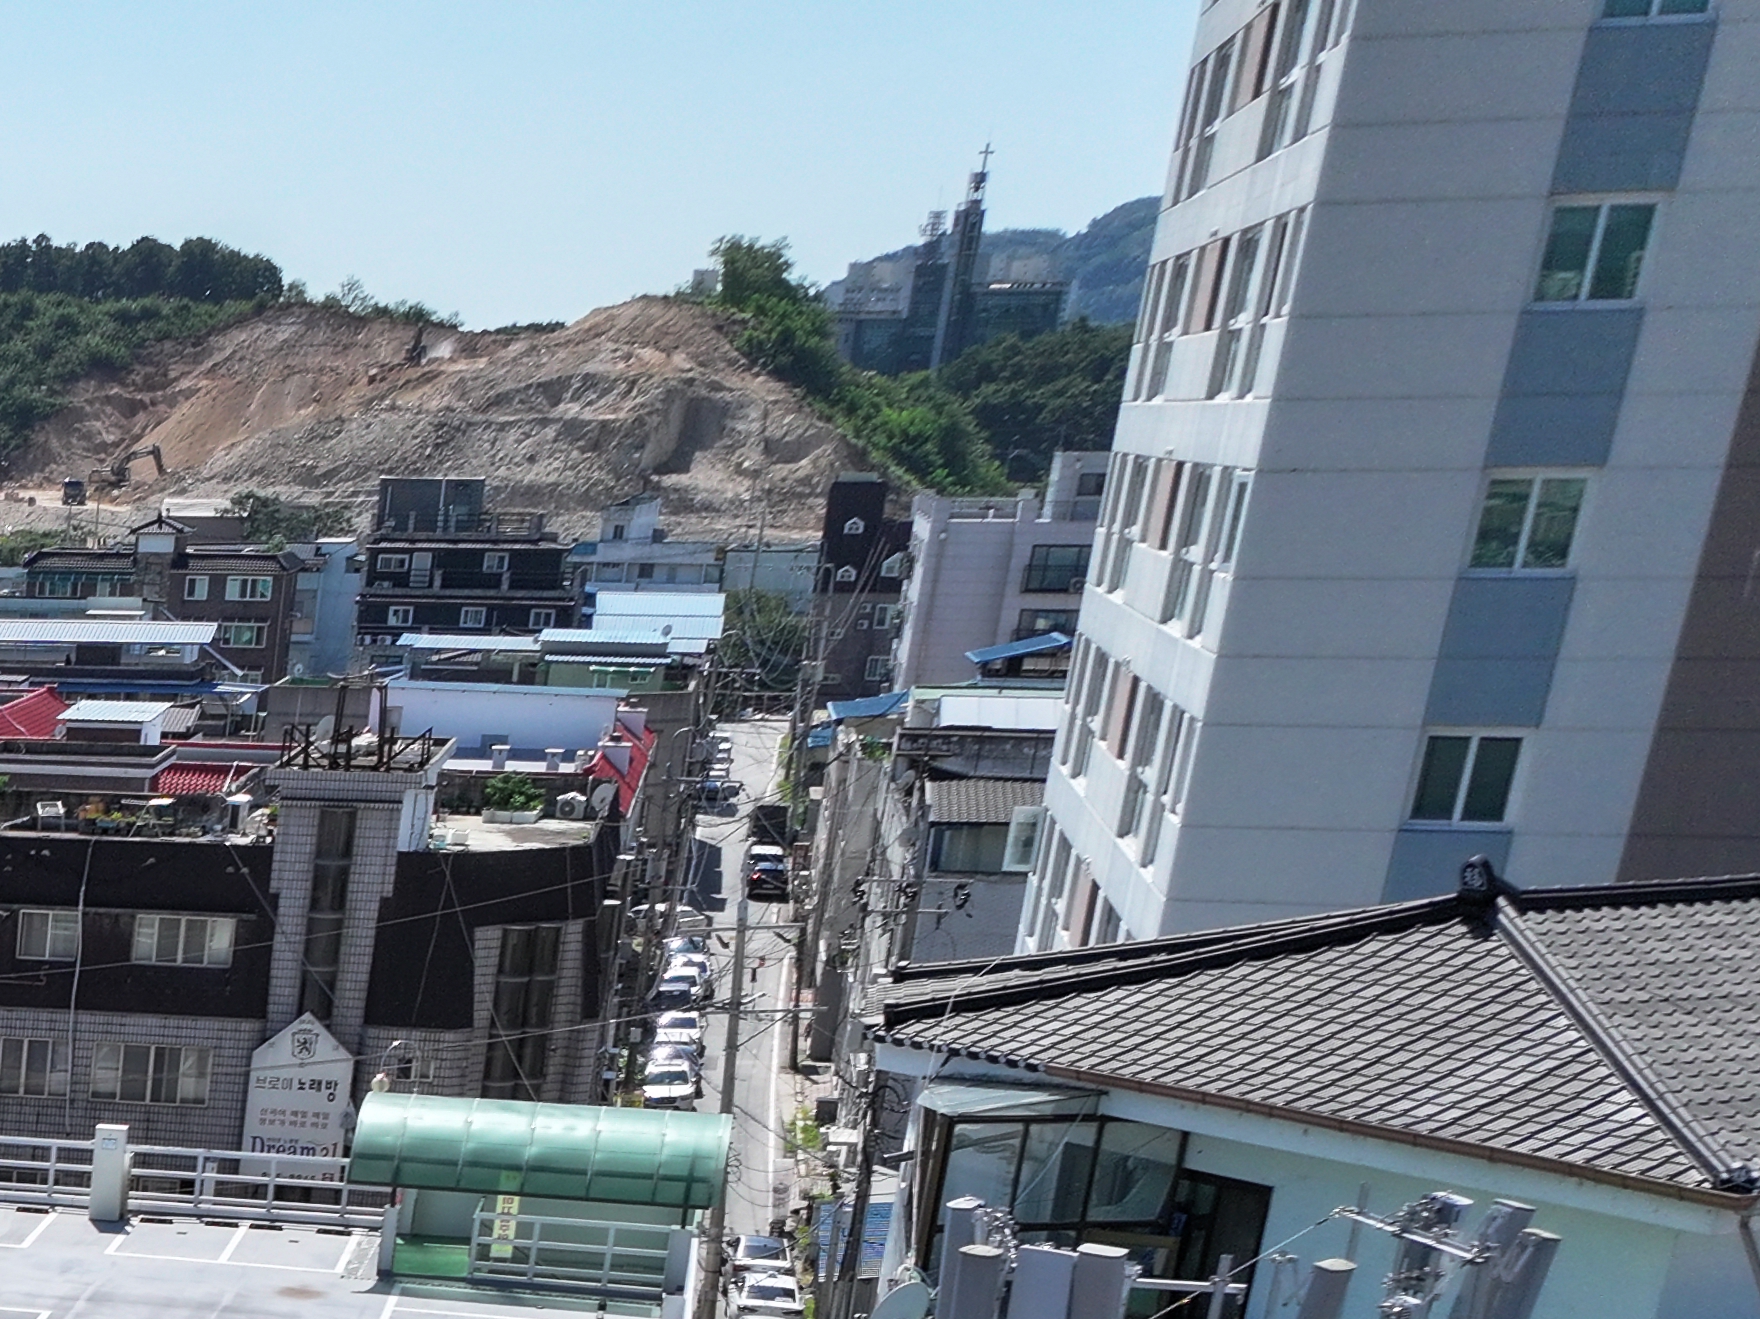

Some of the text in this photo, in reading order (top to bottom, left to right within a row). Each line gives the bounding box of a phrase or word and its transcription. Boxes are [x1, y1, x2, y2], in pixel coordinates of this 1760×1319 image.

[254, 1075, 338, 1103] 브로이 노래방
[250, 1136, 316, 1158] Dream
